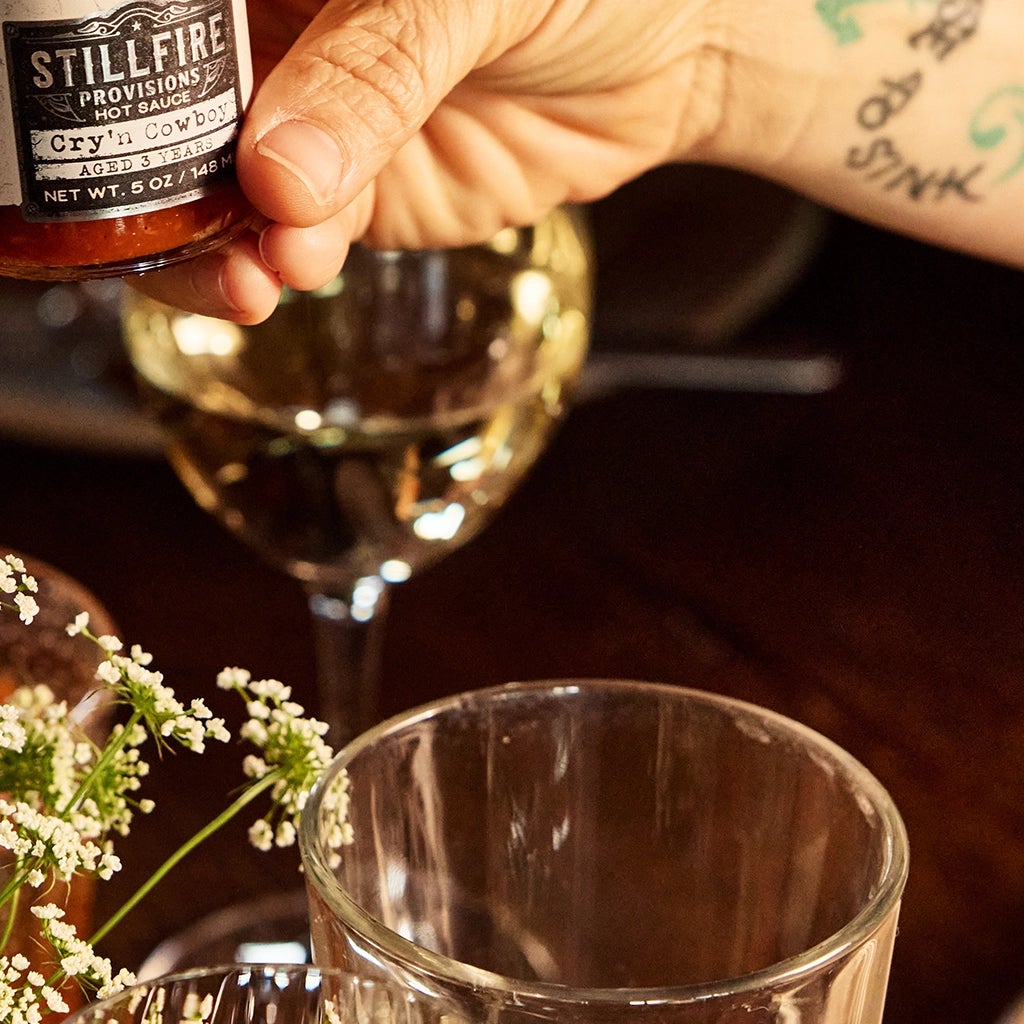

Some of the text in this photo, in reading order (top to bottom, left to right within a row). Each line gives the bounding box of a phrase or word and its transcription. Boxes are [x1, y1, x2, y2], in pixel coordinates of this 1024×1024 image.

[30, 11, 226, 89] STILLFIRE
[79, 68, 201, 108] PROVISIONS
[95, 90, 191, 121] HOT SAUCE
[50, 102, 228, 154] Cry'n Cowboy
[79, 137, 214, 177] AGED 3 YEARS
[44, 188, 81, 202] NET
[87, 185, 126, 199] WT.
[130, 180, 144, 195] 5
[148, 173, 174, 190] OZ
[190, 160, 218, 179] 148
